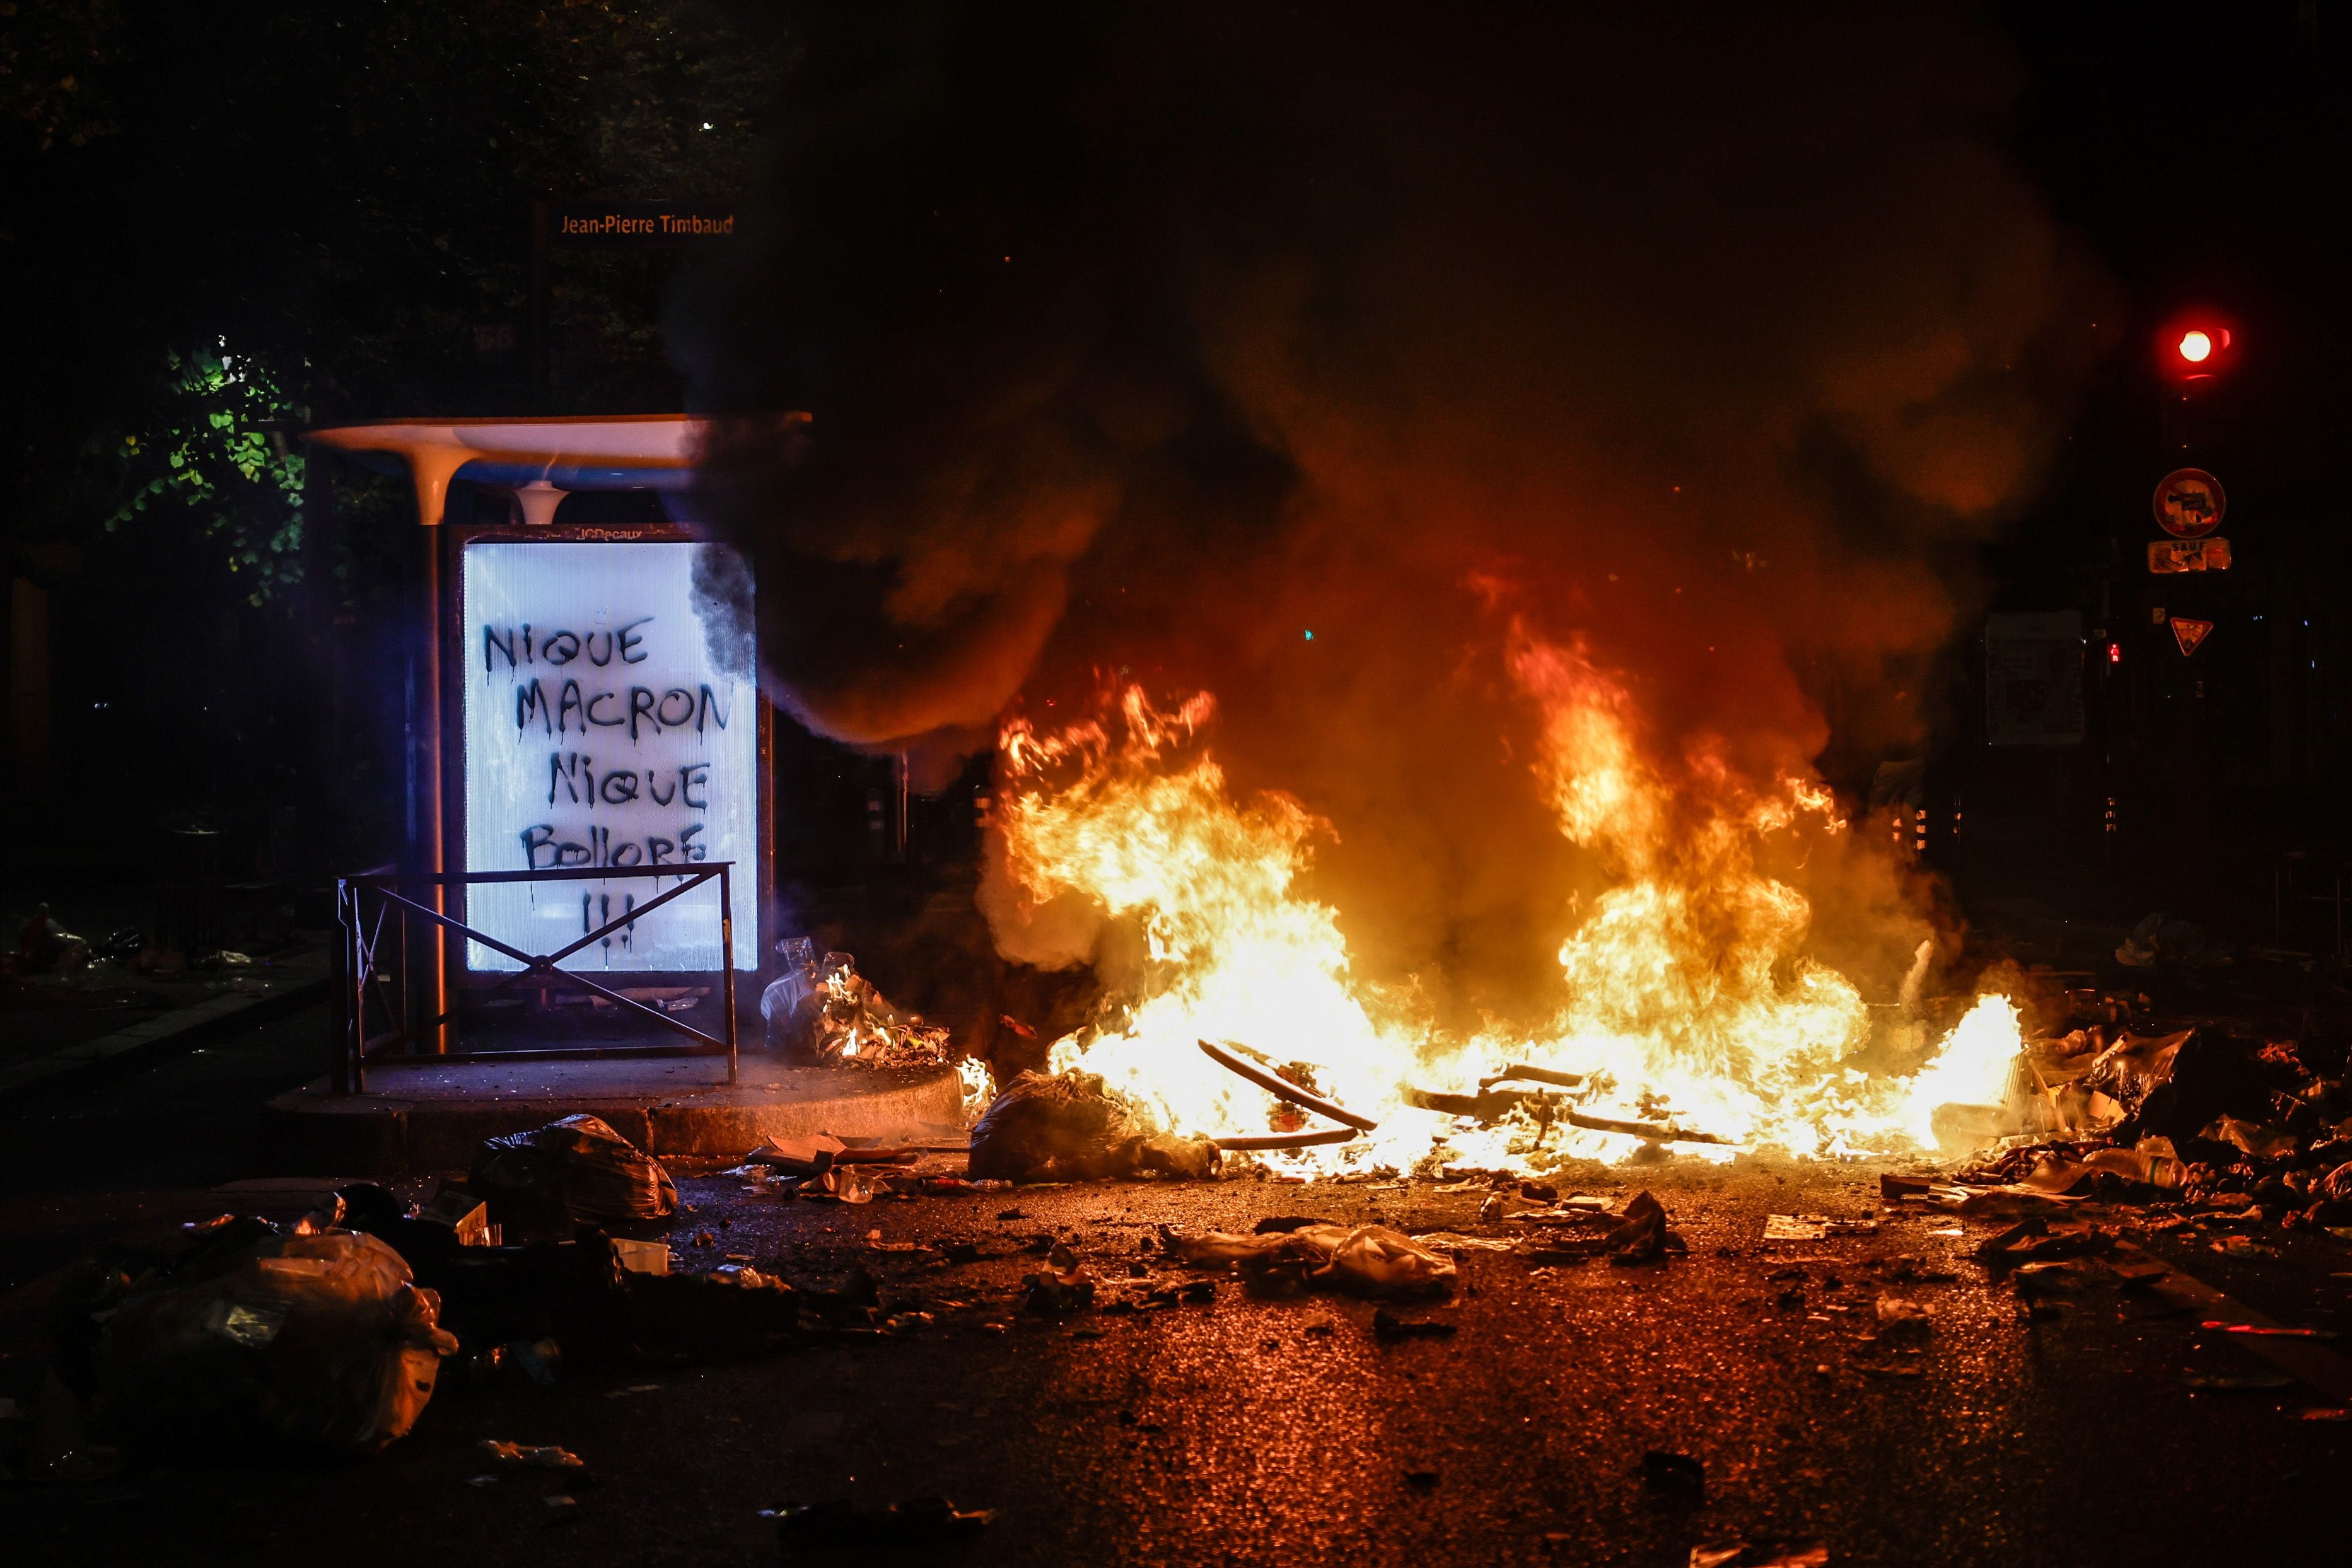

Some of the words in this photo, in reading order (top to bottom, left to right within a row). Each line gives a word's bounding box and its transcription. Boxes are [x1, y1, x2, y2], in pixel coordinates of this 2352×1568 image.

[562, 214, 655, 234] Jean-Pierre
[660, 214, 733, 234] Timbaud
[575, 528, 642, 540] JCDecaux
[2172, 542, 2205, 552] SAUF
[516, 678, 733, 741] MACRON
